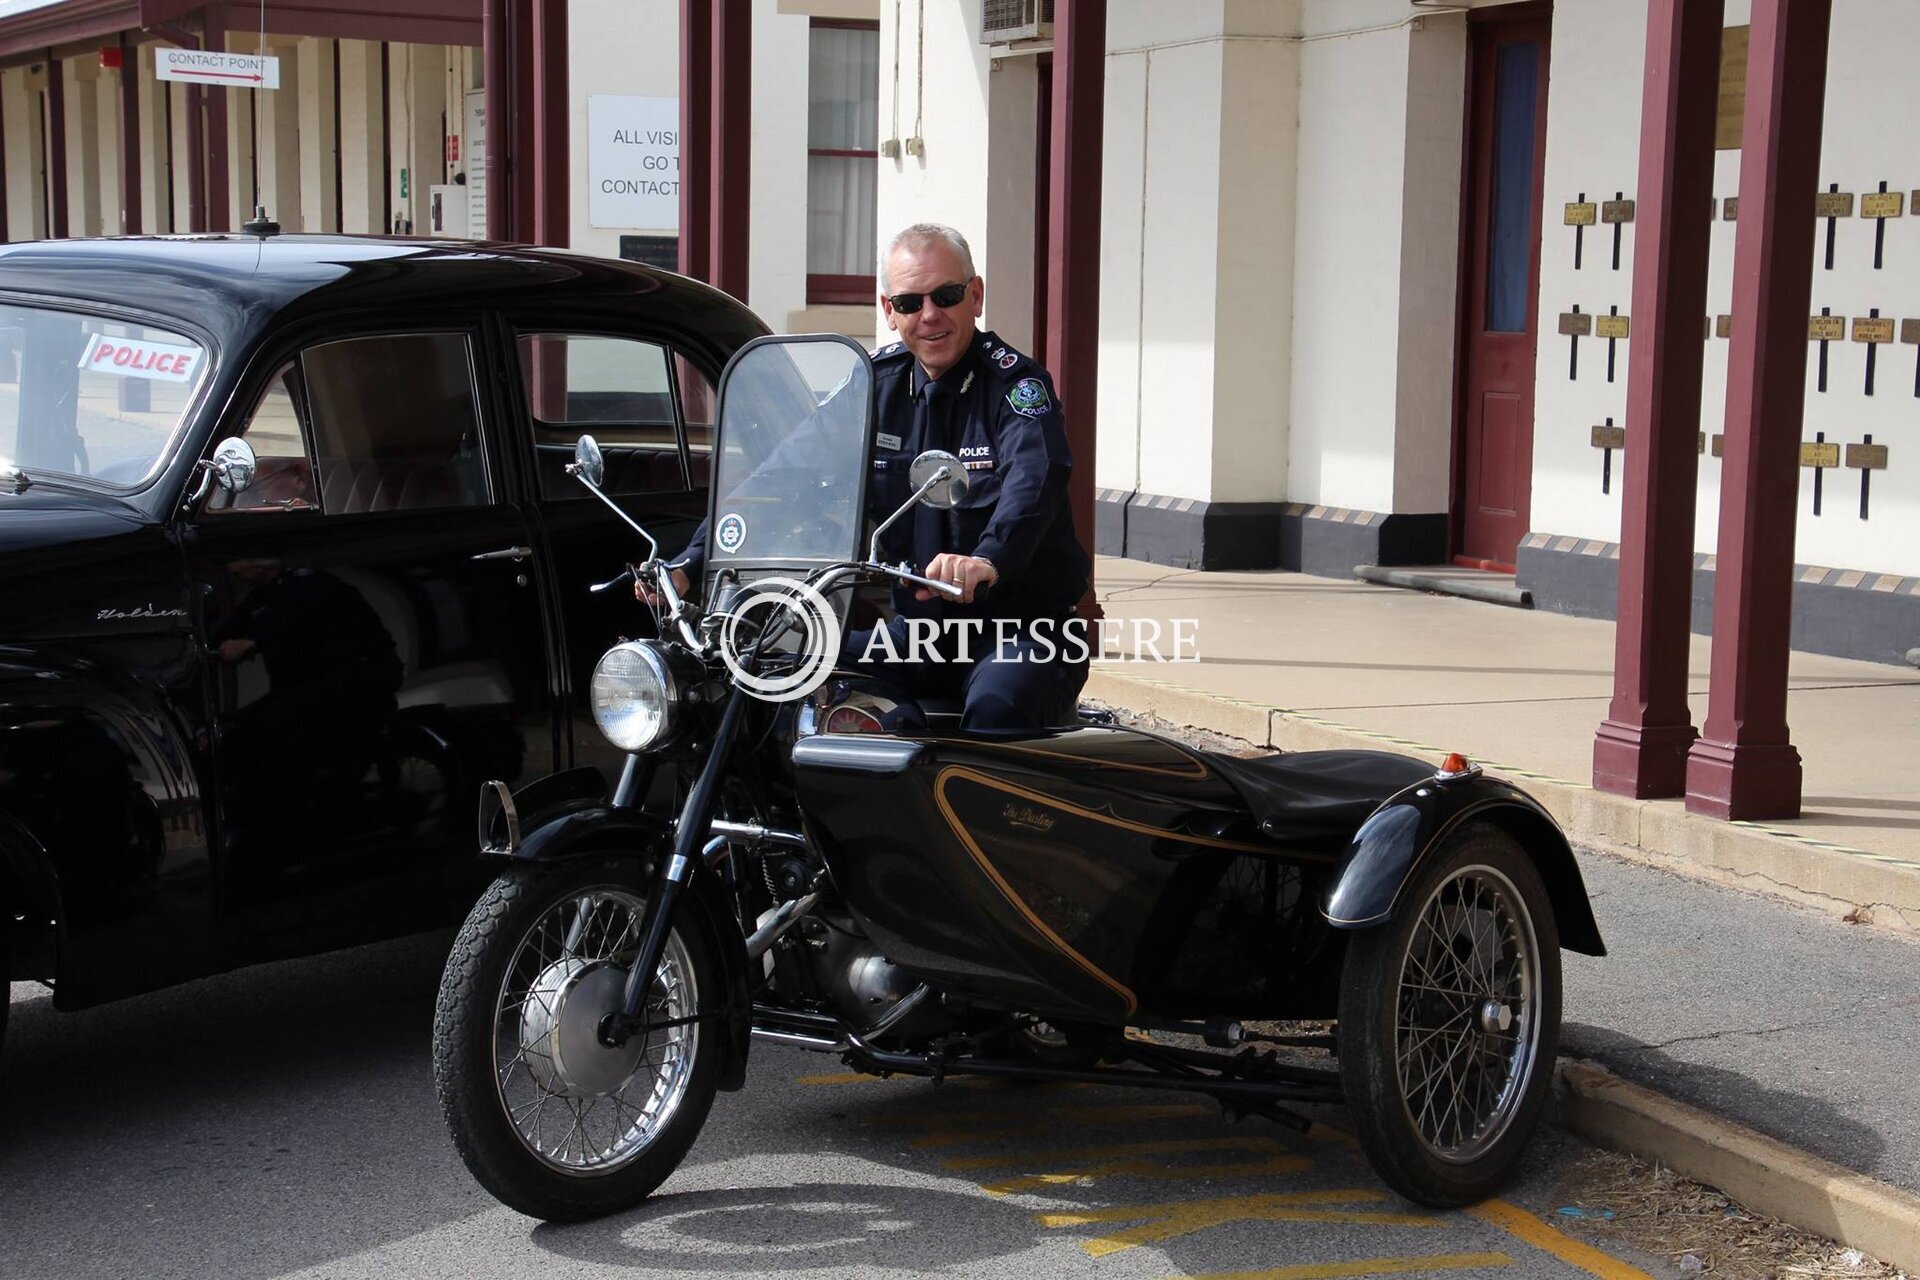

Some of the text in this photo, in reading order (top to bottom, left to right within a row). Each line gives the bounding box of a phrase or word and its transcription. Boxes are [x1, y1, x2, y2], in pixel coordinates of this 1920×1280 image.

[168, 53, 266, 70] CONTACT POINT
[613, 129, 678, 146] ALL VISI
[642, 155, 669, 171] GO
[601, 179, 680, 196] CONTACT
[93, 343, 192, 375] POLICE
[1020, 404, 1049, 415] POLICE
[959, 446, 990, 458] POLICE
[97, 602, 188, 620] Holden
